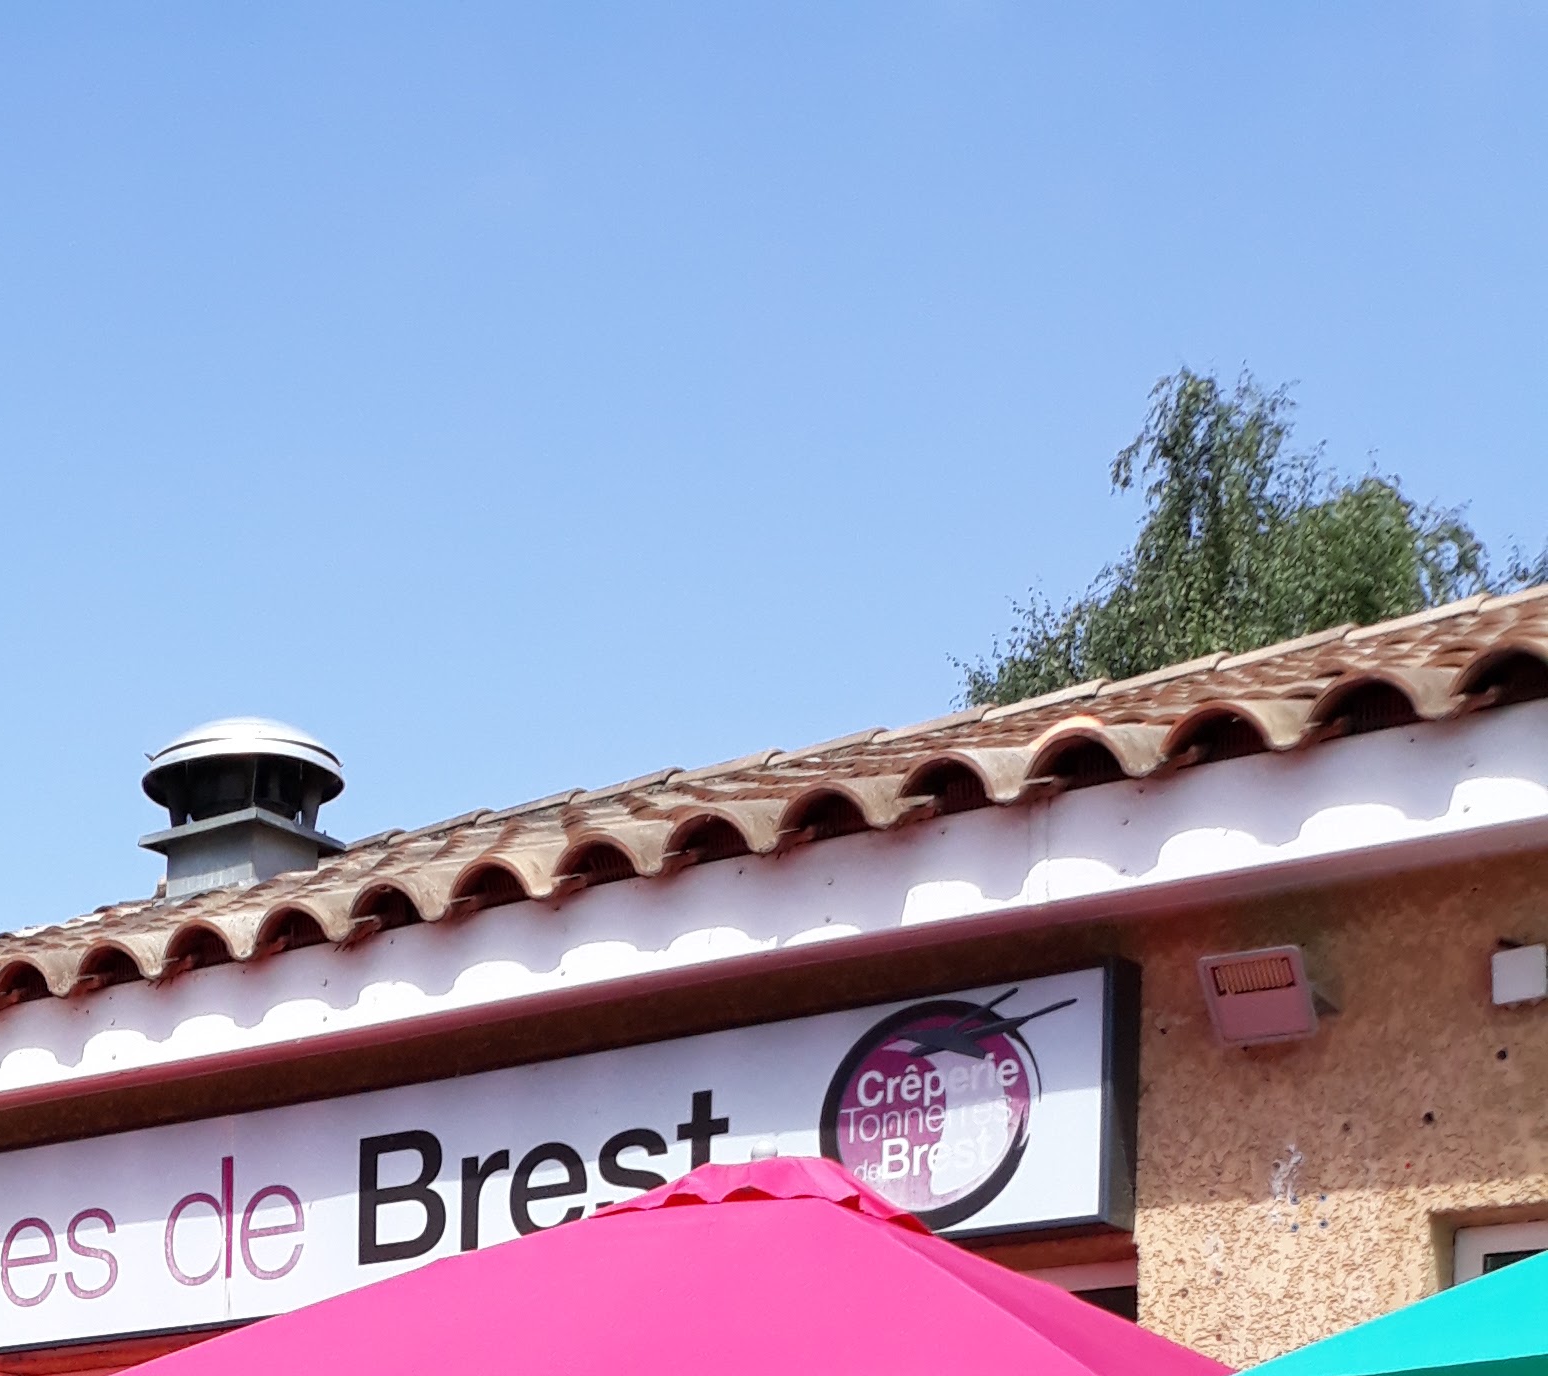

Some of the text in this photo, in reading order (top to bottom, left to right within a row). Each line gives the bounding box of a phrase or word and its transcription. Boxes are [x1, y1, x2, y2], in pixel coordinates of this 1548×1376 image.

[856, 1052, 1020, 1108] Crêperie
[164, 1155, 305, 1287] de
[358, 1090, 730, 1265] Brest
